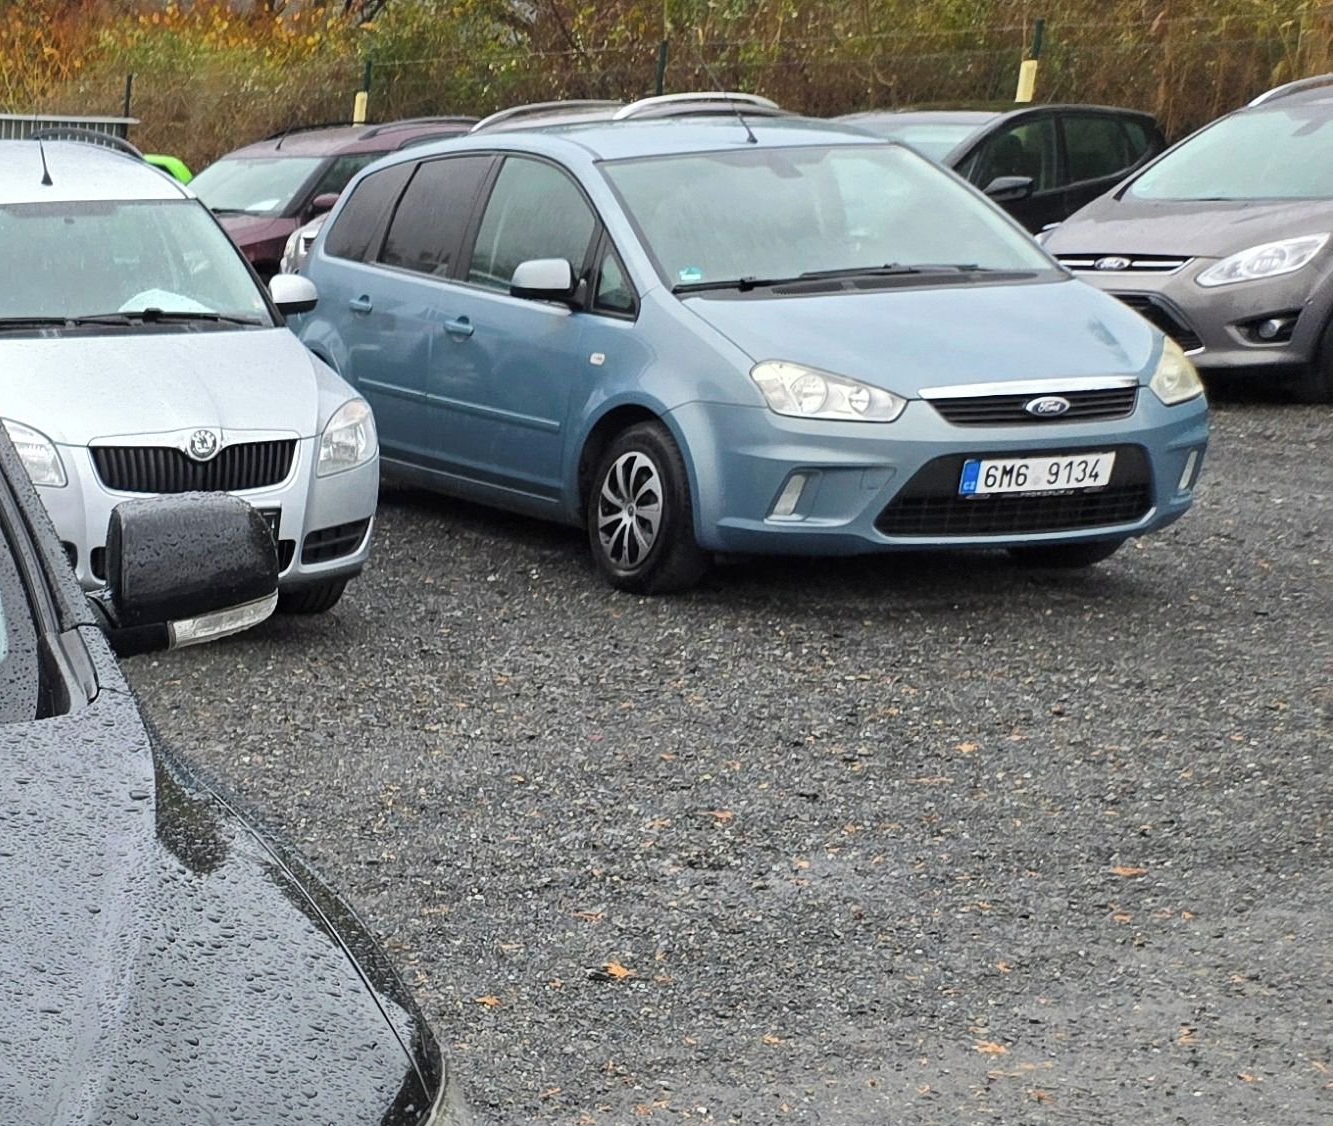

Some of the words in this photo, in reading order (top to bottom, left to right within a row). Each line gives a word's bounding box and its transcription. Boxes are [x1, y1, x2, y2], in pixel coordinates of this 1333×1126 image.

[984, 463, 1030, 489] 6M6
[1046, 458, 1101, 485] 9134
[963, 481, 976, 490] CZ
